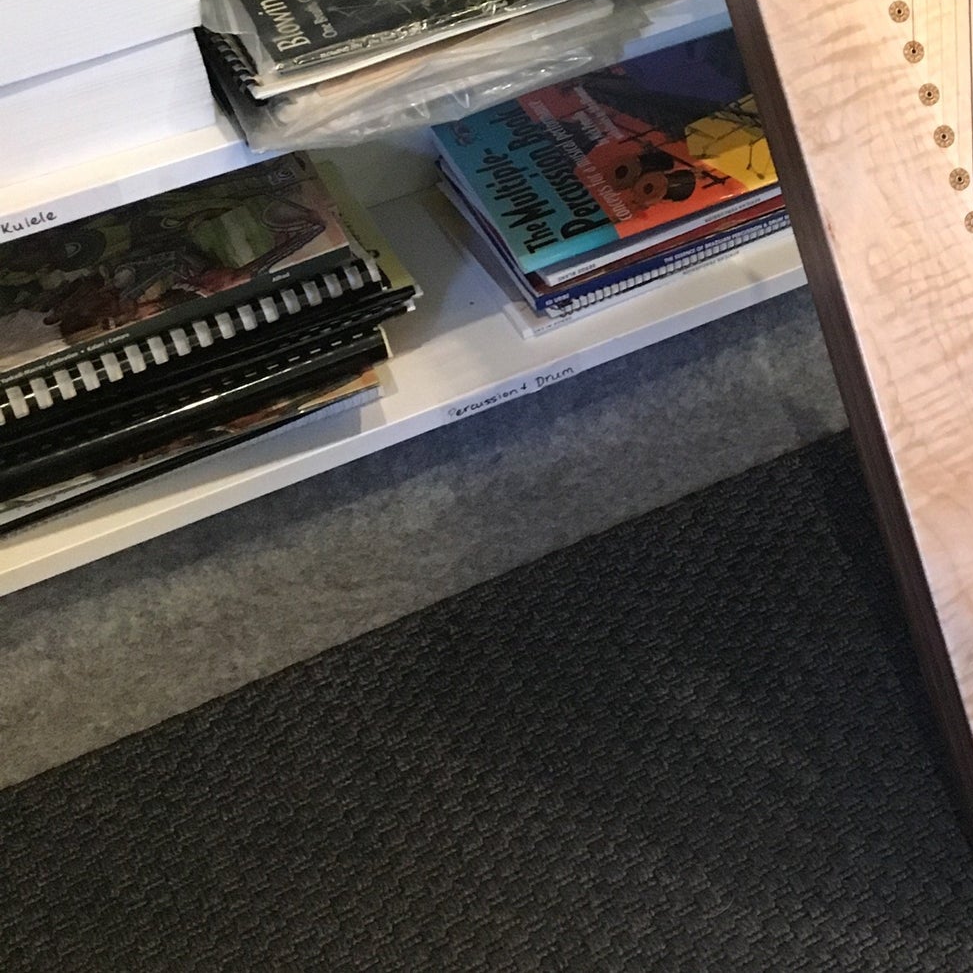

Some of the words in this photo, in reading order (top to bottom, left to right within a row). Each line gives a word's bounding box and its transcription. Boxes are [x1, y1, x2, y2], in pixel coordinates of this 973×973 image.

[320, 22, 337, 35] One
[490, 106, 551, 151] Book
[476, 146, 555, 228] Multiple-
[528, 145, 602, 239] Percussion
[588, 172, 605, 187] for
[597, 184, 632, 221] concepts
[522, 219, 558, 254] The
[270, 269, 291, 283] Alfred
[448, 388, 518, 417] Percussion
[535, 367, 574, 388] Drum
